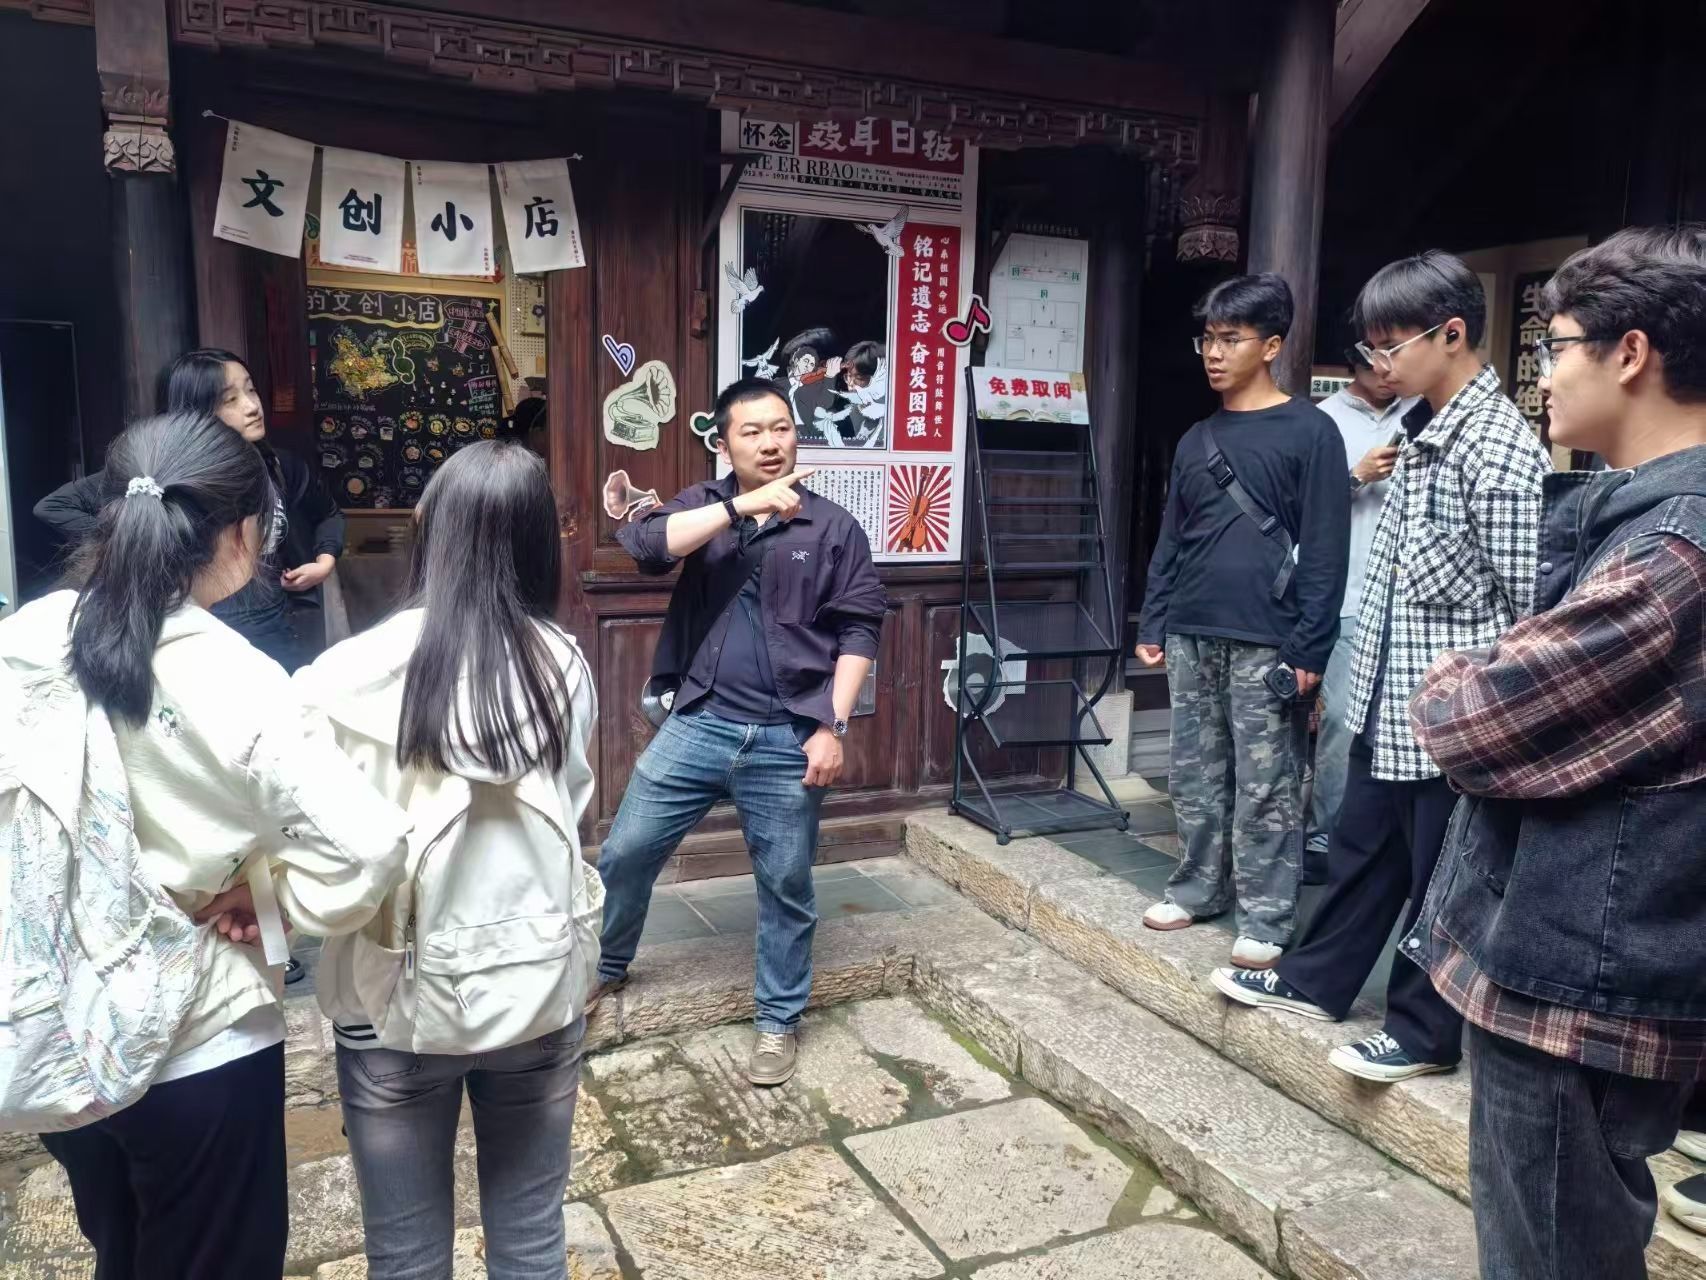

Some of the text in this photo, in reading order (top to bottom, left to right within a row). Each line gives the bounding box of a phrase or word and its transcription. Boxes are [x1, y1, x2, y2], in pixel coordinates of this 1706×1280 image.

[743, 121, 792, 151] 怀念
[778, 156, 801, 174] ER
[806, 159, 853, 179] RBAO
[307, 291, 437, 322] 的文创小店
[907, 235, 934, 437] 铭记遗志 奋发图强
[988, 376, 1072, 400] 免费取阅
